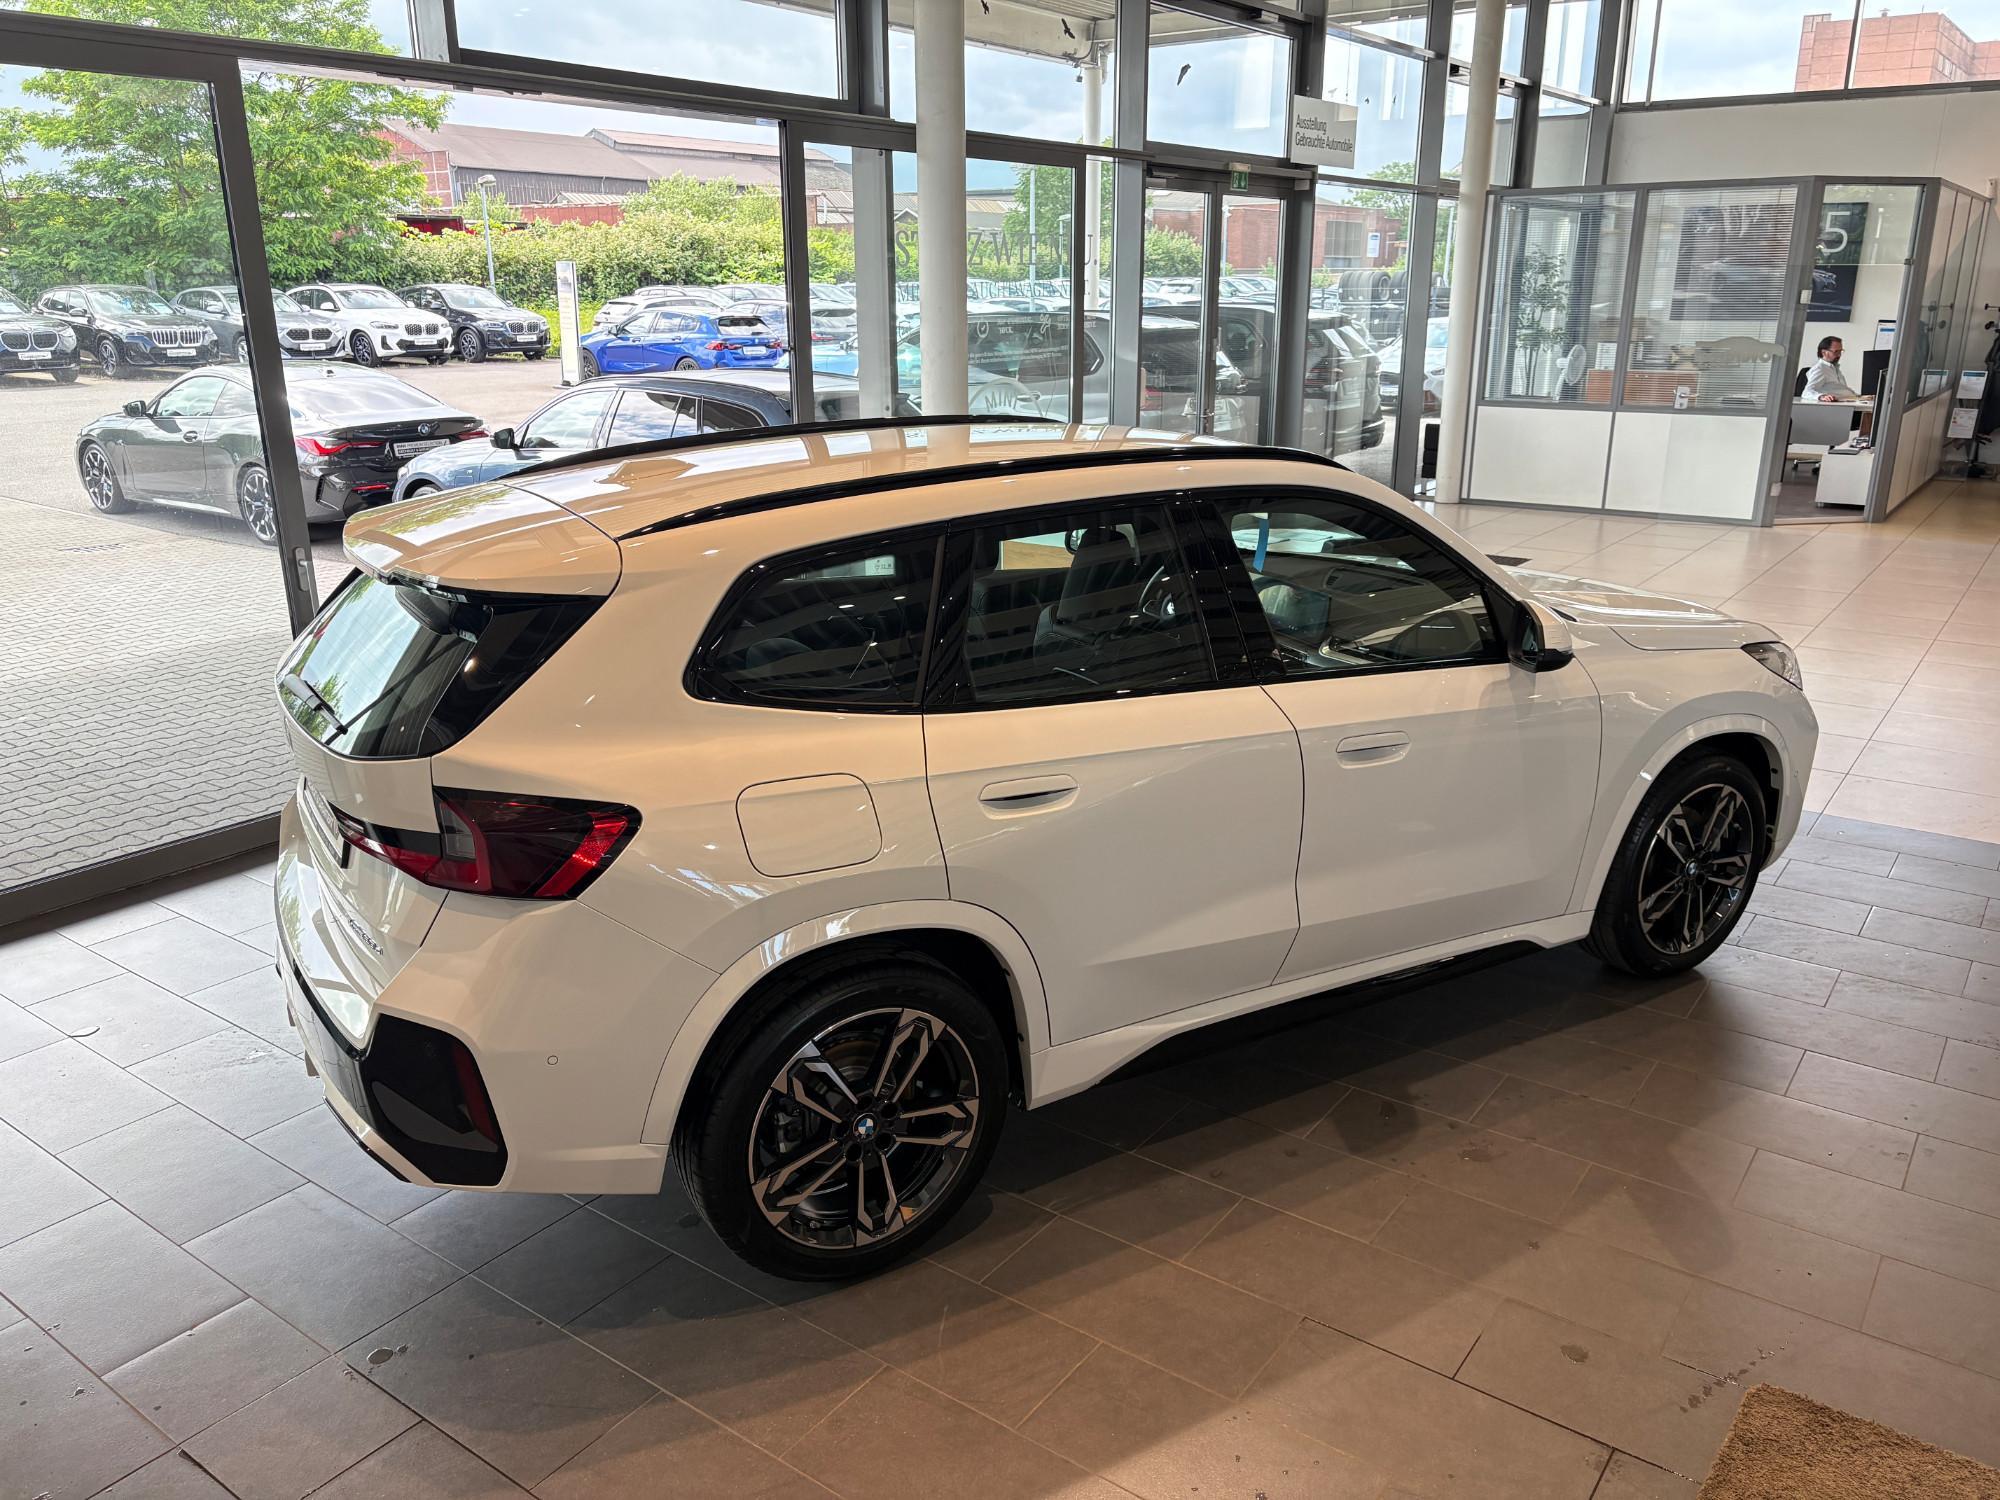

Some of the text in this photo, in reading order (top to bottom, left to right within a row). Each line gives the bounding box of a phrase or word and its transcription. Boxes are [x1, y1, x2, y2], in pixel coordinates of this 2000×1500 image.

[1295, 114, 1327, 135] Ausstellung
[1295, 132, 1353, 153] Gebrauchte Automobile
[1821, 211, 1851, 254] 5
